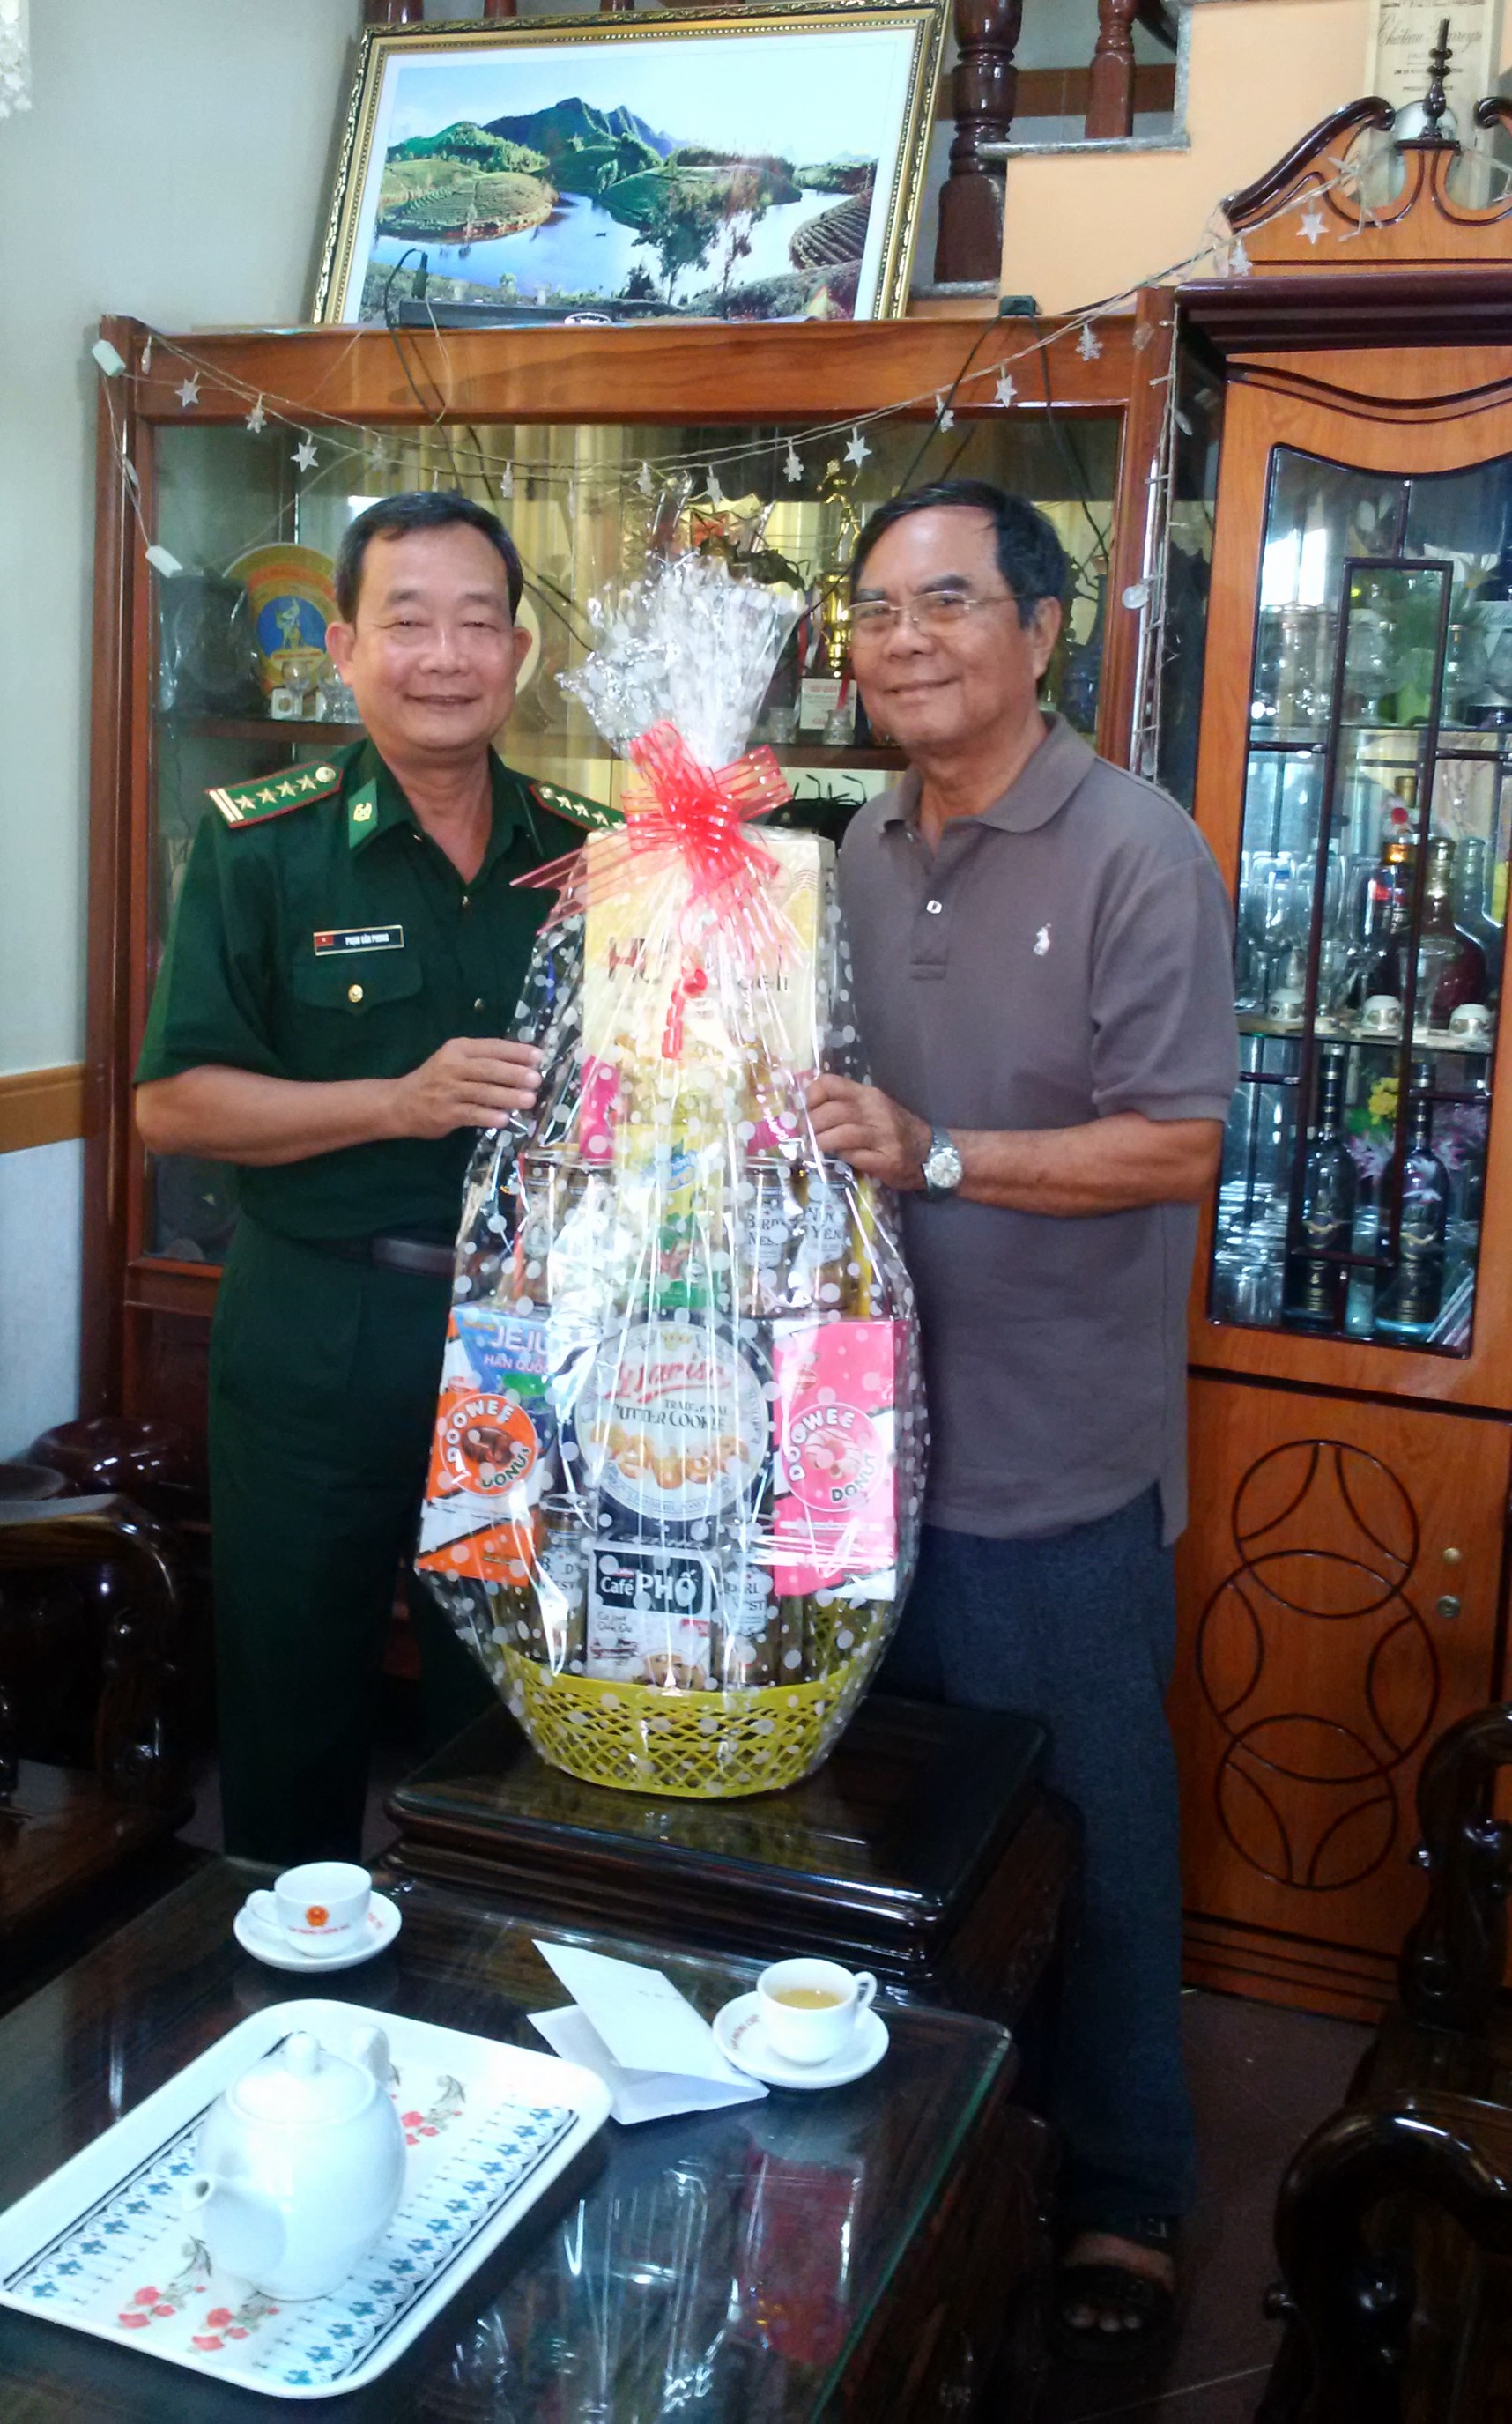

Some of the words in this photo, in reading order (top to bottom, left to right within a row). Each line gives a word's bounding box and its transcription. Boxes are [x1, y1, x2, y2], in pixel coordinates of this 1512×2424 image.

[614, 1405, 665, 1425] UTTER
[788, 1407, 855, 1481] DOOWEE
[831, 1451, 876, 1501] DONUT
[600, 1575, 634, 1596] Café
[635, 1569, 698, 1607] PHỐ
